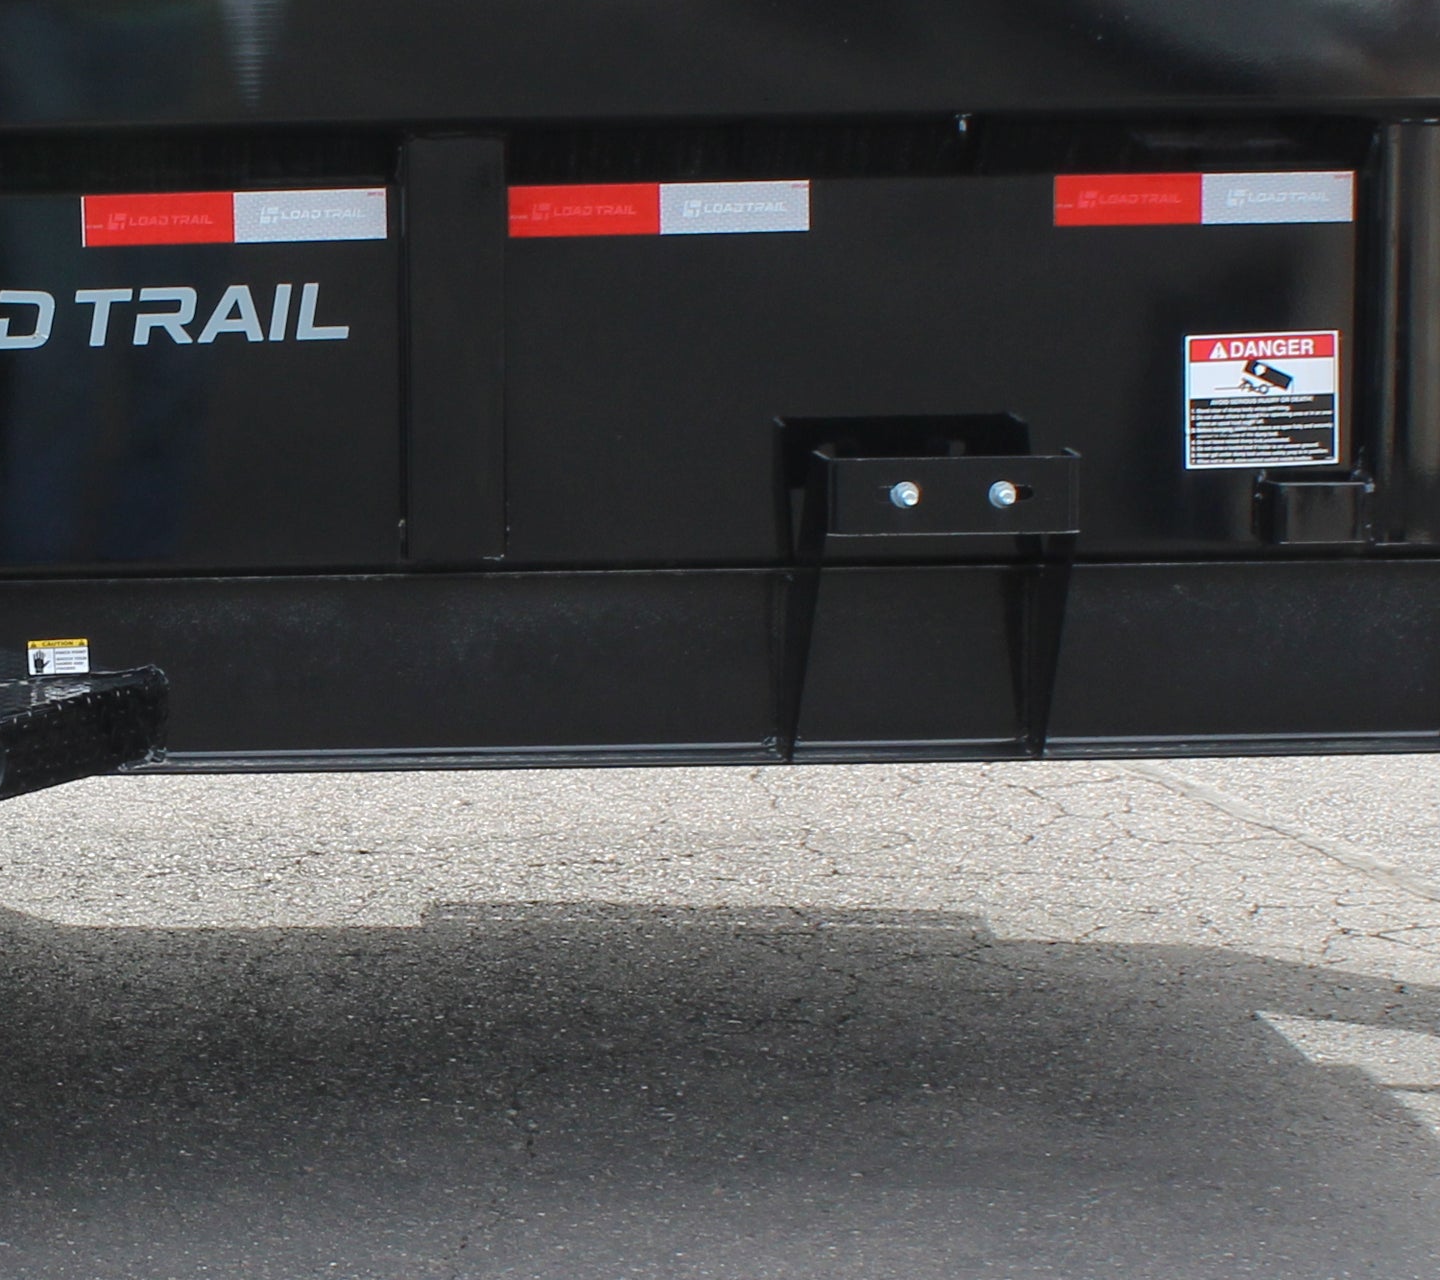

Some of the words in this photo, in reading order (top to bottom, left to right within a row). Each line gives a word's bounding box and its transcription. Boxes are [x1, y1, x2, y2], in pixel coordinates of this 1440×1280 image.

[129, 216, 169, 226] LOAD
[171, 215, 214, 225] TRAIL
[75, 282, 350, 348] TRAIL
[1230, 339, 1314, 358] DANGER
